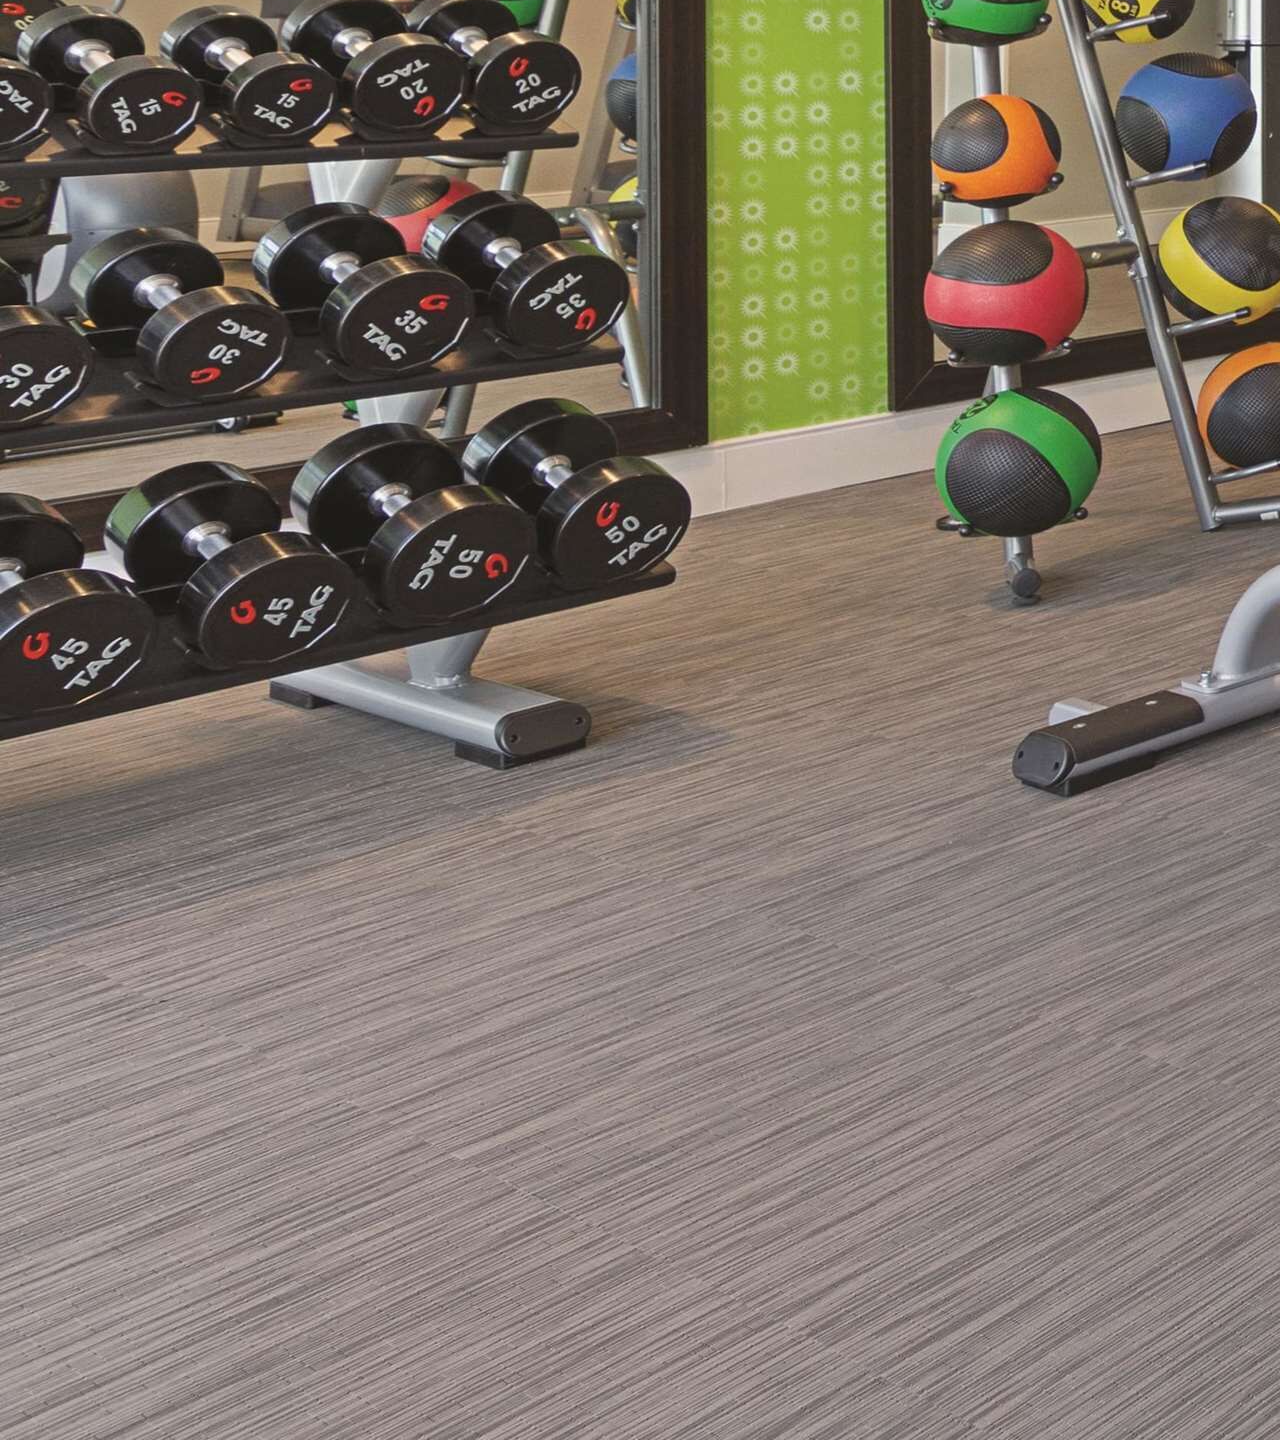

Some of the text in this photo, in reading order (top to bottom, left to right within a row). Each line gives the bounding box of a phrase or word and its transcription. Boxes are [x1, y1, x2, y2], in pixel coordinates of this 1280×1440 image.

[1111, 0, 1130, 14] 8
[376, 59, 430, 88] TAG
[515, 73, 542, 94] 20
[276, 92, 300, 109] 15
[400, 78, 428, 100] 20
[512, 85, 562, 113] TAG
[111, 97, 137, 134] TAG
[138, 98, 162, 116] 15
[252, 104, 294, 129] TAG
[529, 272, 583, 311] TAG
[555, 293, 586, 320] 35
[217, 318, 269, 348] TAG
[394, 310, 429, 335] 35
[208, 344, 241, 365] 30
[362, 323, 407, 361] TAG
[0, 363, 34, 389] 30
[9, 364, 72, 409] TAG
[604, 515, 640, 544] 50
[607, 523, 668, 568] TAG
[408, 533, 457, 591] TAG
[449, 548, 484, 579] 50
[263, 597, 294, 627] 45
[289, 584, 334, 639] TAG
[50, 637, 90, 671] 45
[63, 635, 132, 690] TAG
